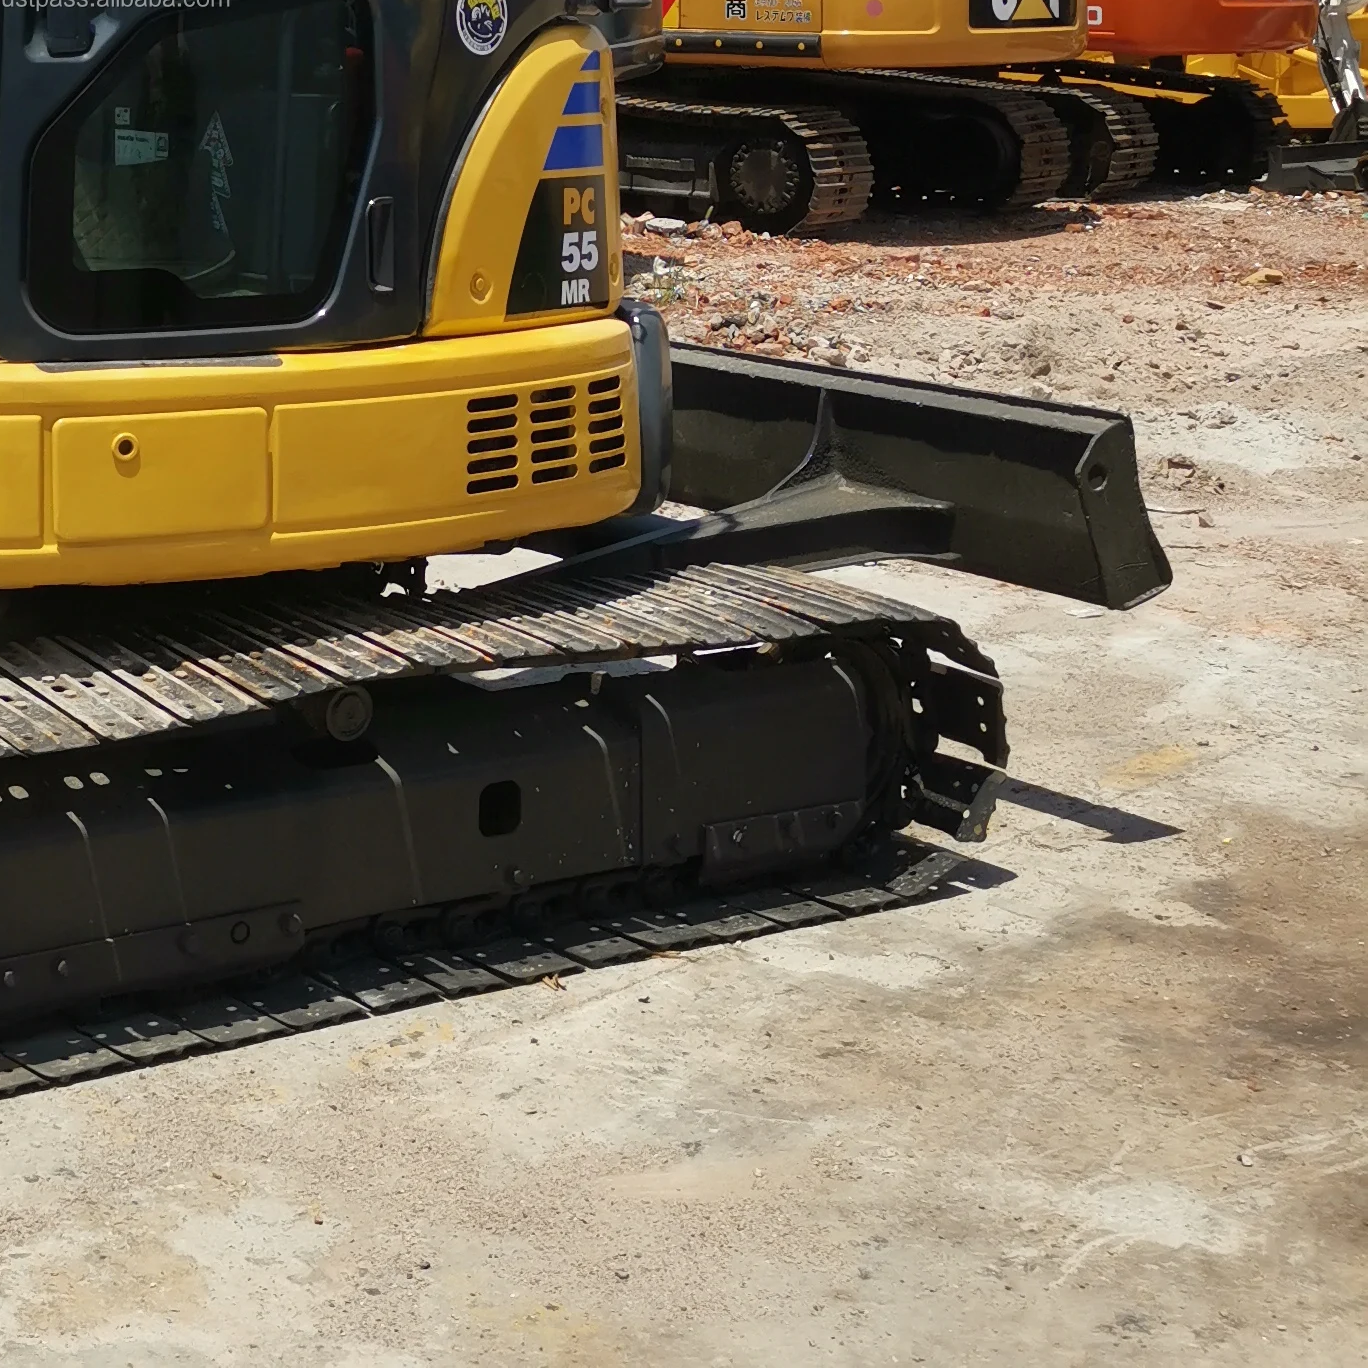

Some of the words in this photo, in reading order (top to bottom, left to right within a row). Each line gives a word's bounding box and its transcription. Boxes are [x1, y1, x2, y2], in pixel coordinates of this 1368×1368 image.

[563, 187, 595, 225] PC
[561, 230, 599, 273] 55
[560, 278, 590, 306] MR
